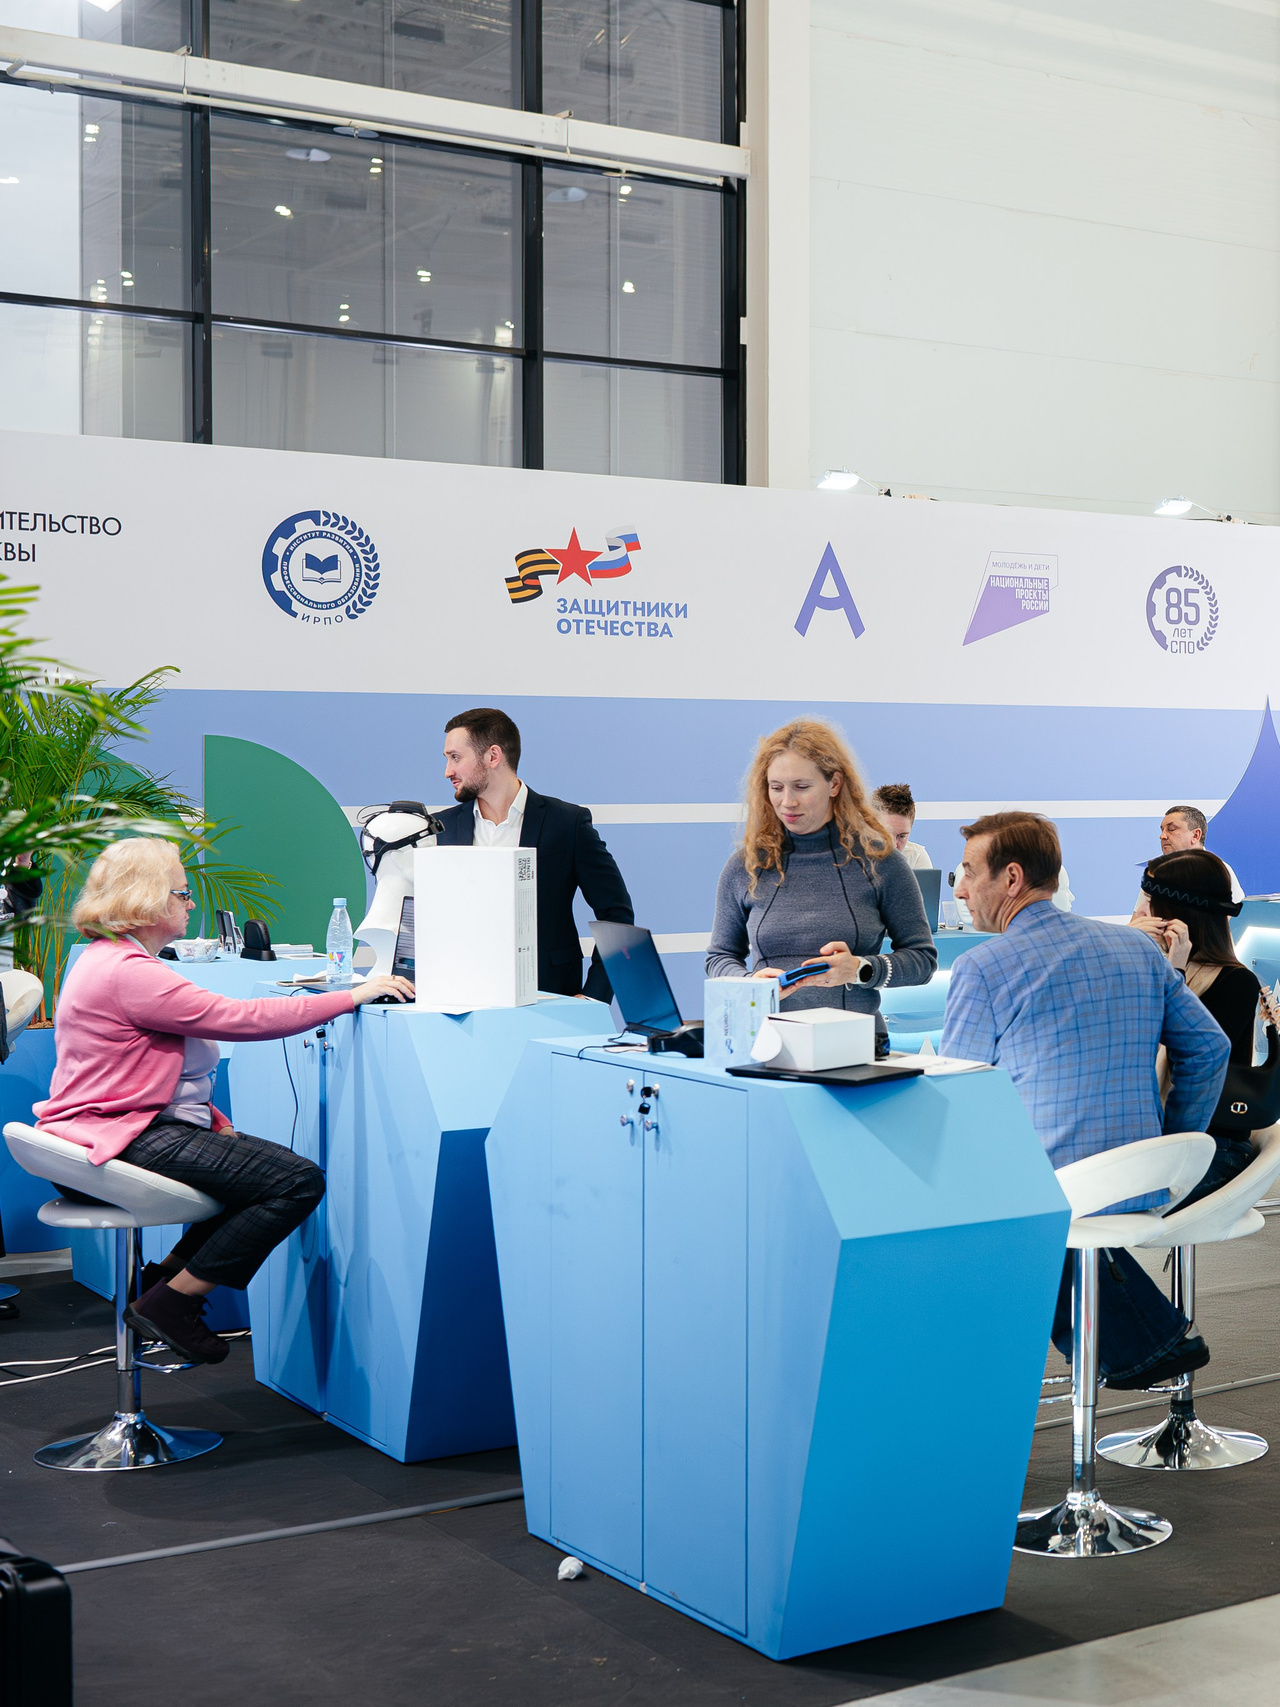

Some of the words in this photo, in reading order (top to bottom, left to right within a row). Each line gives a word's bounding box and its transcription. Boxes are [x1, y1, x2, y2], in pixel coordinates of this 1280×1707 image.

[0, 541, 36, 562] ВЫ
[289, 531, 320, 552] ИНСТИТУТ
[322, 532, 354, 554] РАЗВИТИЯ
[337, 563, 361, 606] ОБРАЗОВАНИЯ
[990, 576, 1049, 590] НАЦИОНАЛЬНЫЕ
[1015, 588, 1049, 601] ПРОЕКТЫ
[556, 597, 688, 619] ЗАЩИТНИКИ
[1021, 600, 1049, 612] РОССИИ
[1165, 587, 1200, 626] 85
[301, 612, 344, 626] ИРПО
[556, 618, 673, 638] ОТЕЧЕСТВА
[1170, 640, 1195, 654] СПО
